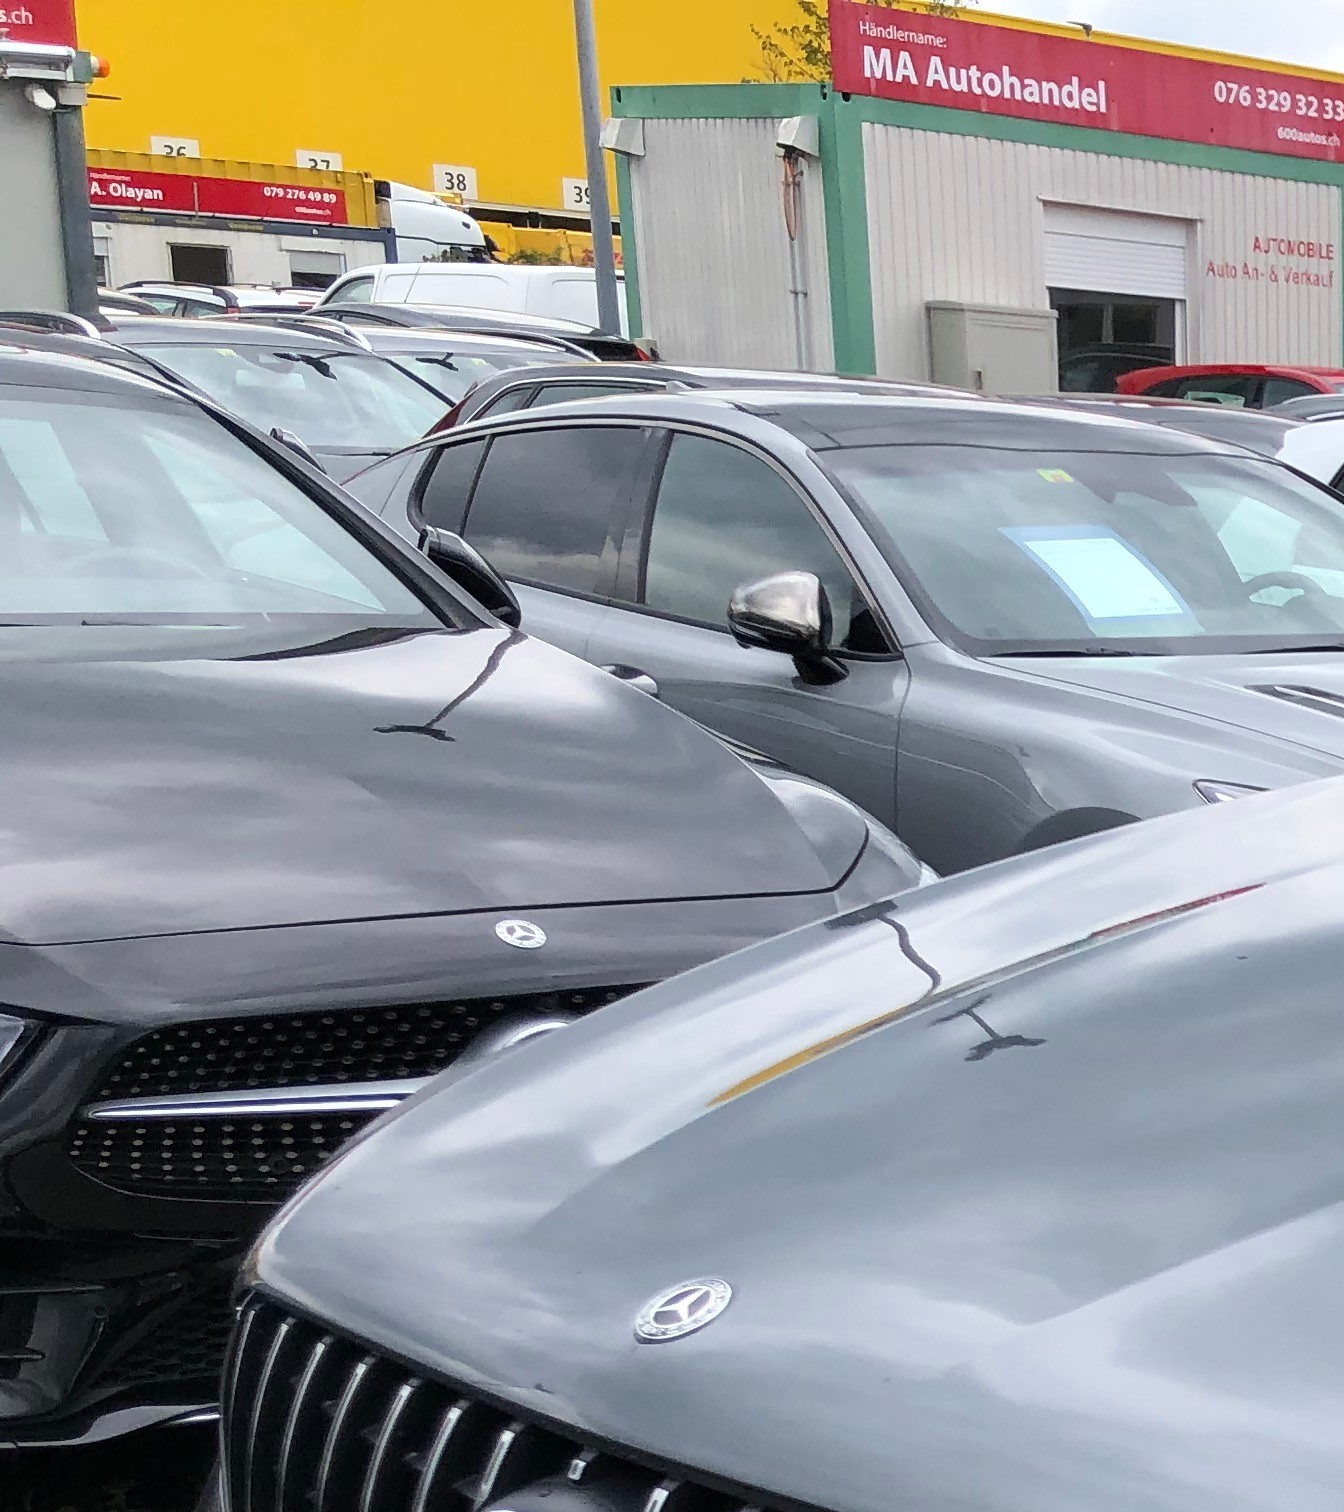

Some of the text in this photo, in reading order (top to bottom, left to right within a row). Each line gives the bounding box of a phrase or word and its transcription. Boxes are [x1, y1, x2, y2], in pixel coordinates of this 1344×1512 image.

[859, 21, 948, 48] Händlername:
[863, 44, 1107, 113] MA Autohandel
[1213, 80, 1252, 107] 076
[1255, 87, 1292, 113] 329
[1295, 93, 1319, 118] 32
[90, 181, 164, 202] A. Olayan
[444, 172, 468, 192] 38
[263, 186, 337, 204] 079 276 49 89
[1252, 236, 1334, 261] AUTOMOBLE
[1206, 259, 1237, 279] Auto
